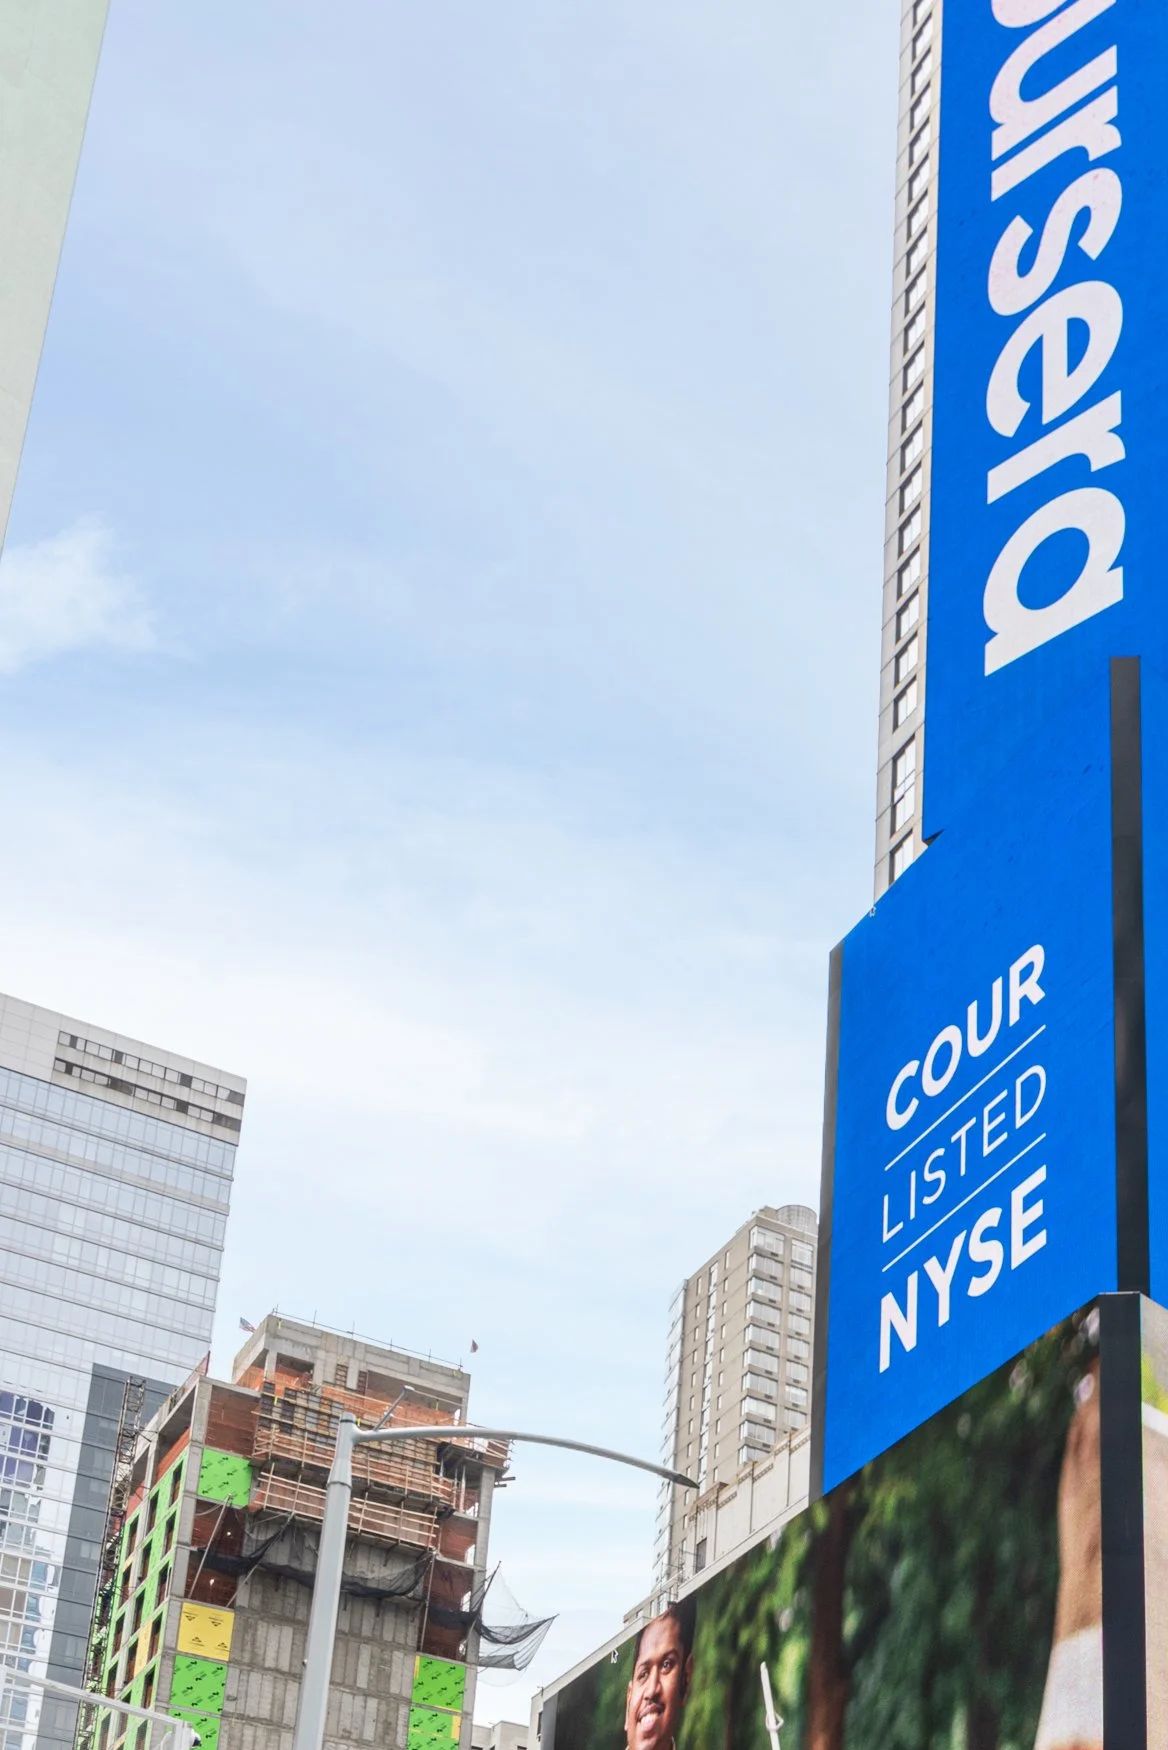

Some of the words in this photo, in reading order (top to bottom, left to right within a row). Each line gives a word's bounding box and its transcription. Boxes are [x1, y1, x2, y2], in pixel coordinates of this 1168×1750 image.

[983, 0, 1126, 677] ursera
[885, 944, 1046, 1131] COUR
[882, 1064, 1047, 1244] LISTED
[879, 1164, 1047, 1373] NYSE
